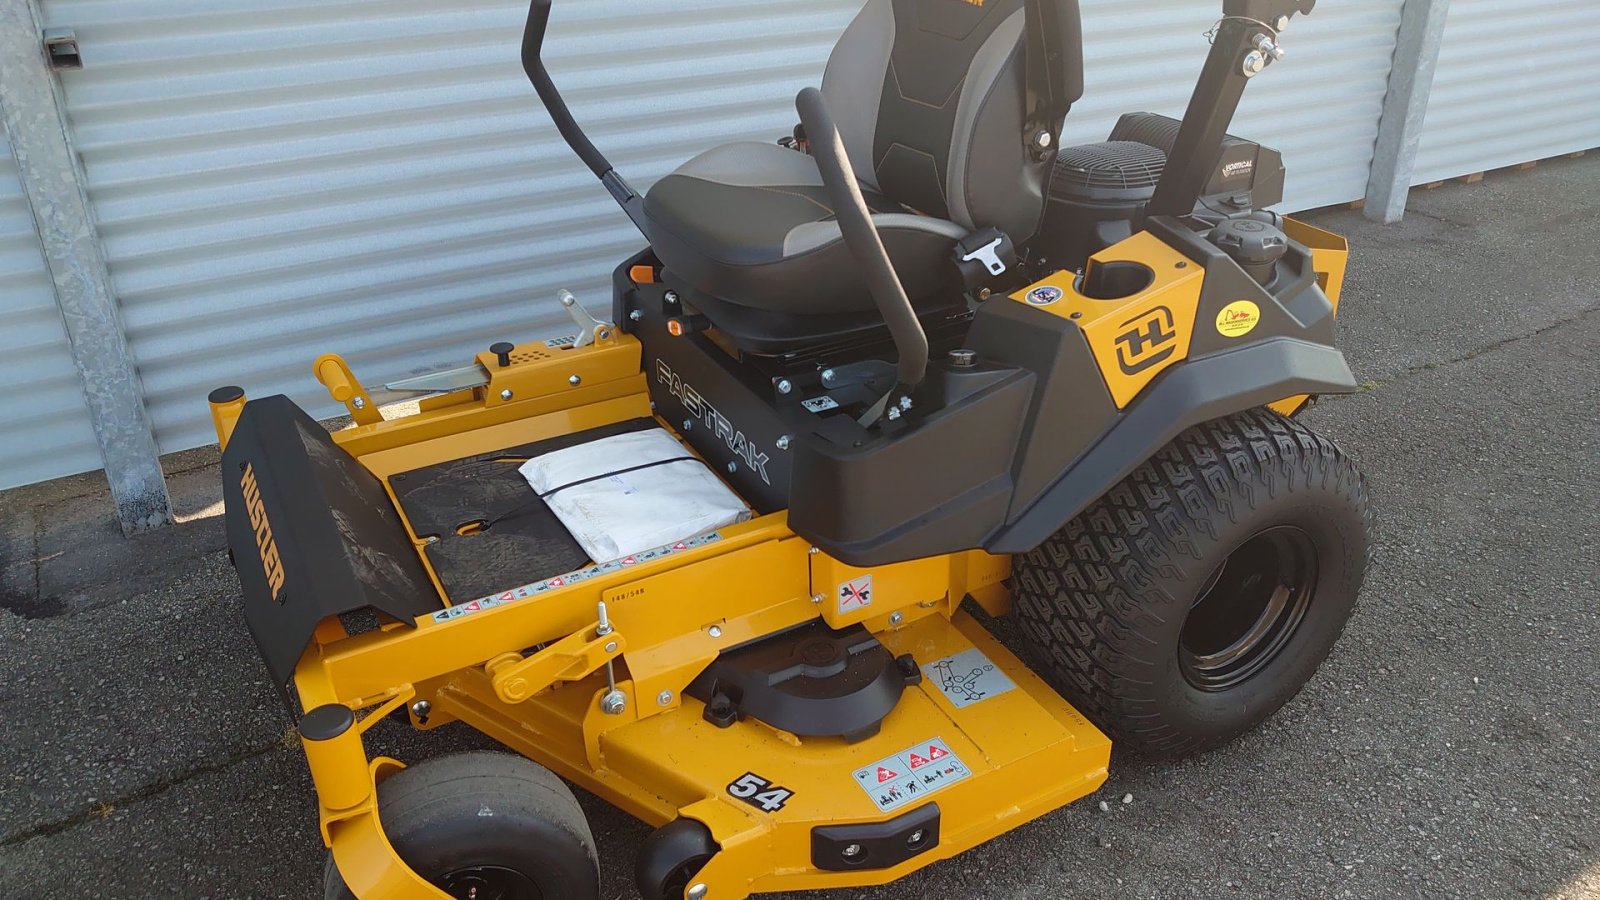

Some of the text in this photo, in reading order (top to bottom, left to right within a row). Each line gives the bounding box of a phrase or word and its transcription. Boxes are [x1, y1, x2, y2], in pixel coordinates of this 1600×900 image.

[656, 358, 770, 486] FASTRAK
[240, 461, 285, 601] HUSTLER
[728, 773, 792, 811] 54
